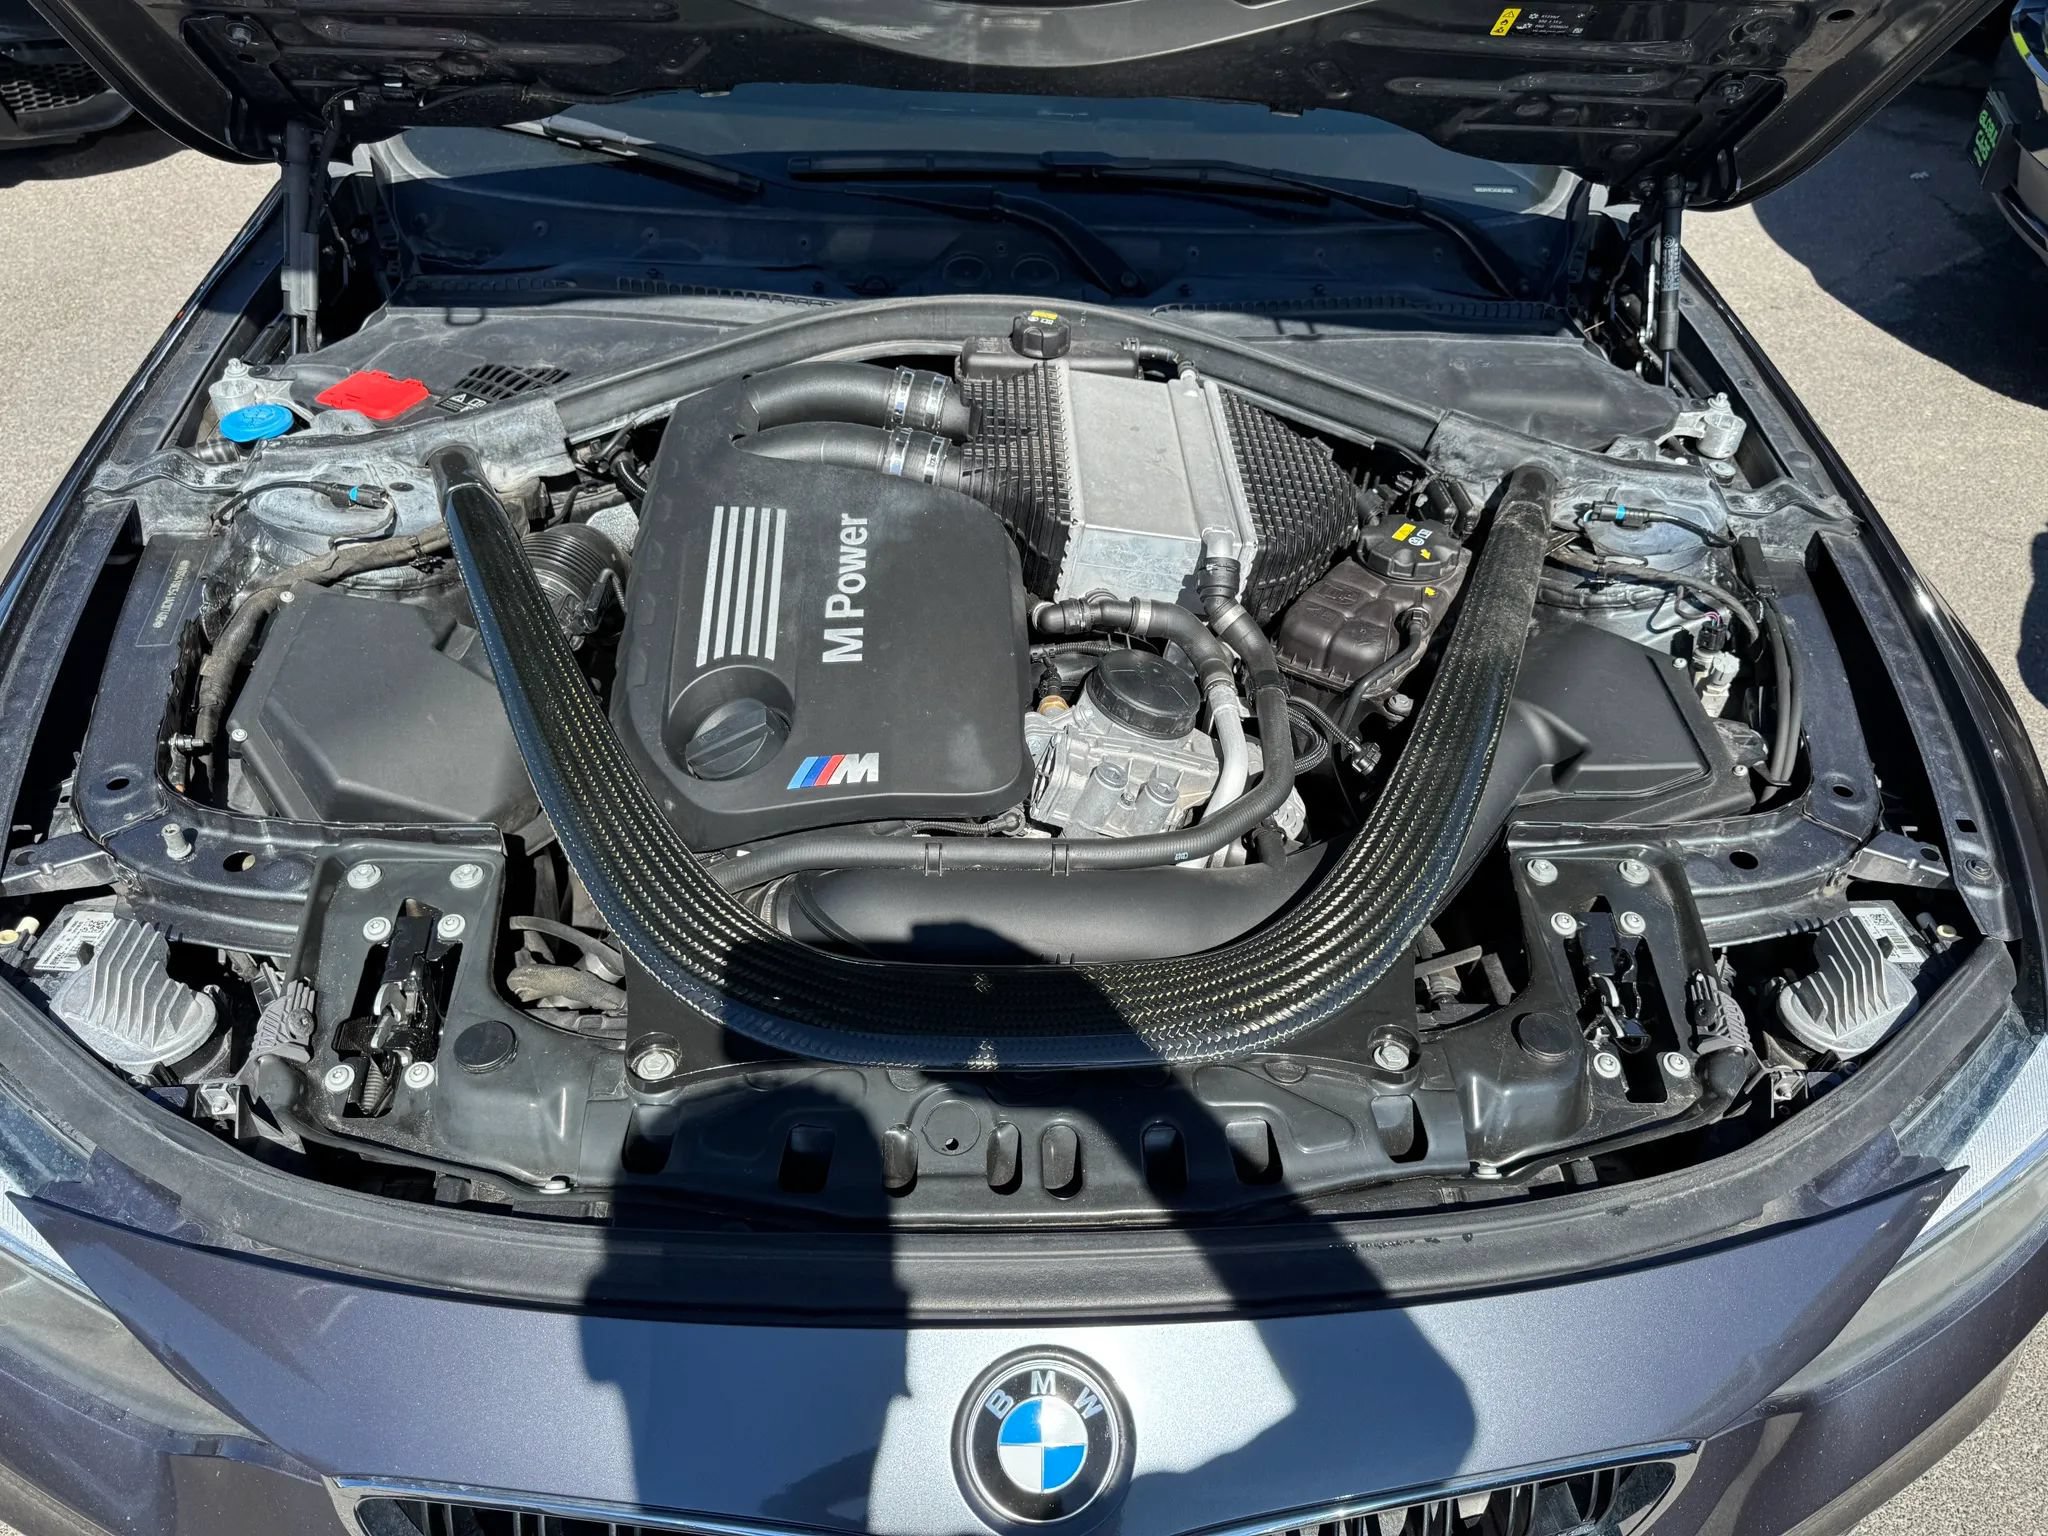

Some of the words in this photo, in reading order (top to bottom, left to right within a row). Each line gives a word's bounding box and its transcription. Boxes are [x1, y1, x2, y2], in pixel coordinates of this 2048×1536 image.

[824, 512, 868, 619] Power
[822, 627, 864, 663] M
[826, 752, 880, 785] M
[985, 1370, 1103, 1420] BMW
